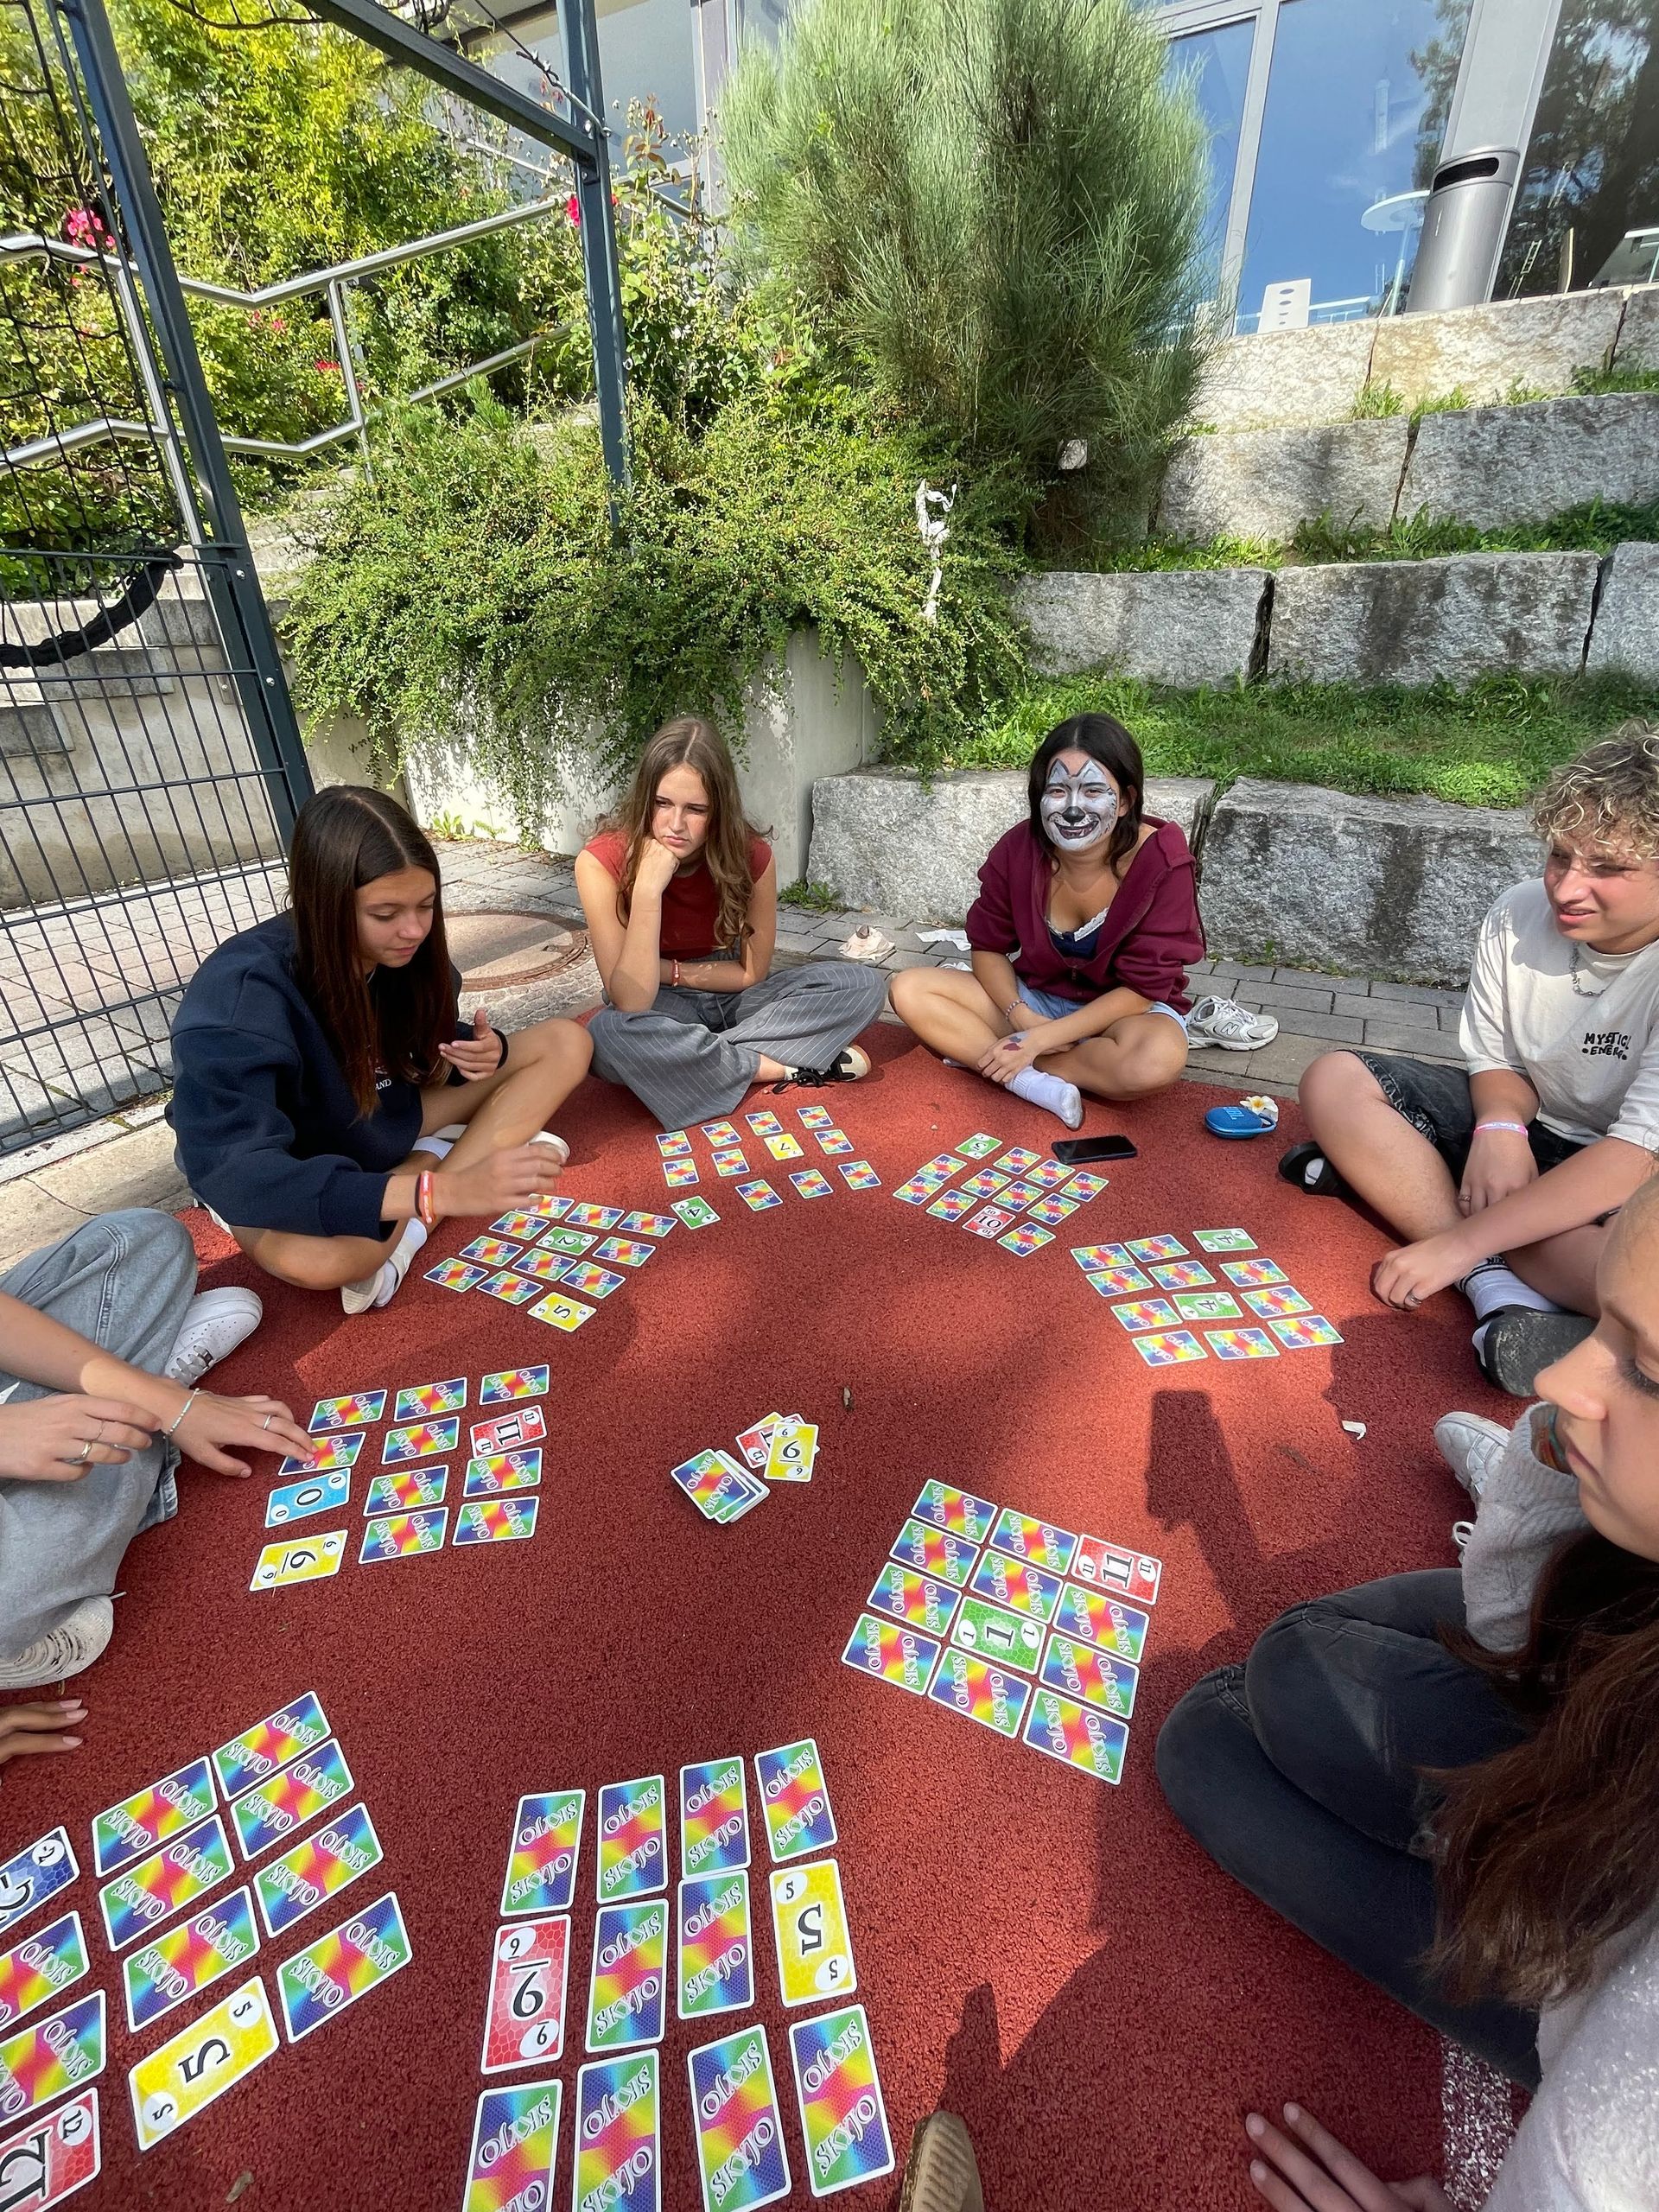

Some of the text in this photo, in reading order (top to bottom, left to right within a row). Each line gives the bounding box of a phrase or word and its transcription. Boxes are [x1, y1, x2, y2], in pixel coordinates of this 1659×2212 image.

[1221, 1022, 1239, 1035] N
[557, 1236, 577, 1245] 2
[978, 1217, 1001, 1228] 10
[554, 1306, 570, 1319] 5
[497, 1418, 522, 1445] 11
[779, 1440, 802, 1463] 6
[687, 1455, 715, 1489] SKYJO
[704, 1476, 733, 1512] SKYJO
[296, 1488, 322, 1506] 0
[931, 1486, 945, 1522] SKYJO
[963, 1497, 978, 1537] SKYJO
[911, 1526, 925, 1565] SKYJO
[1009, 1515, 1026, 1554] SKYJO
[1043, 1528, 1061, 1568] SKYJO
[944, 1540, 961, 1580] SKYJO
[990, 1557, 1008, 1597] SKYJO
[1081, 1563, 1095, 1575] 11
[1103, 1554, 1135, 1588] 11
[1139, 1562, 1153, 1573] 11
[891, 1570, 905, 1613] SKYJO
[925, 1584, 941, 1629] SKYJO
[1026, 1572, 1045, 1616] SKYJO
[963, 1630, 975, 1639] 1
[1072, 1592, 1093, 1637] SKYJO
[1109, 1605, 1134, 1654] SKYJO
[865, 1622, 882, 1669] SKYJO
[986, 1628, 1015, 1648] 1
[902, 1635, 920, 1686] SKYJO
[952, 1656, 969, 1707] SKYJO
[1058, 1643, 1081, 1691] SKYJO
[990, 1674, 1010, 1727] SKYJO
[1097, 1658, 1125, 1710] SKYJO
[271, 1713, 321, 1744] SKYJO
[1042, 1697, 1067, 1753] SKYJO
[1085, 1714, 1112, 1774] SKYJO
[226, 1744, 272, 1775] SKYJO
[293, 1763, 343, 1799] SKYJO
[766, 1749, 814, 1797] SKYJO
[159, 1780, 203, 1820] SKYJO
[604, 1785, 659, 1834] SKYJO
[687, 1764, 740, 1813] SKYJO
[105, 1810, 152, 1849] SKYJO
[243, 1796, 294, 1831] SKYJO
[518, 1798, 577, 1846] SKYJO
[775, 1796, 823, 1849] SKYJO
[319, 1830, 371, 1870] SKYJO
[687, 1816, 741, 1866] SKYJO
[168, 1843, 220, 1885] SKYJO
[267, 1865, 319, 1906] SKYJO
[509, 1853, 571, 1905] SKYJO
[603, 1837, 659, 1892] SKYJO
[116, 1879, 166, 1920] SKYJO
[684, 1881, 742, 1937] SKYJO
[786, 1881, 793, 1897] 5
[194, 1916, 247, 1963] SKYJO
[346, 1922, 400, 1970] SKYJO
[510, 1938, 520, 1960] 9
[600, 1911, 659, 1967] SKYJO
[798, 1904, 823, 1957] 5
[19, 1942, 76, 1986] SKYJO
[139, 1948, 188, 1999] SKYJO
[290, 1958, 344, 2008] SKYJO
[685, 1943, 745, 2004] SKYJO
[829, 1960, 838, 1979] 5
[234, 2001, 254, 2019] 5
[512, 1961, 549, 2018] 9
[594, 1976, 659, 2037] SKYJO
[43, 2019, 92, 2078] SKYJO
[179, 2037, 231, 2084] 5
[803, 2018, 862, 2093] SKYJO
[701, 2040, 762, 2120] SKYJO
[62, 2110, 83, 2138] 12
[153, 2103, 174, 2123] 5
[584, 2066, 652, 2140] SKYJO
[479, 2094, 552, 2169] SKYJO
[814, 2094, 876, 2176] SKYJO
[705, 2121, 772, 2205] SKYJO
